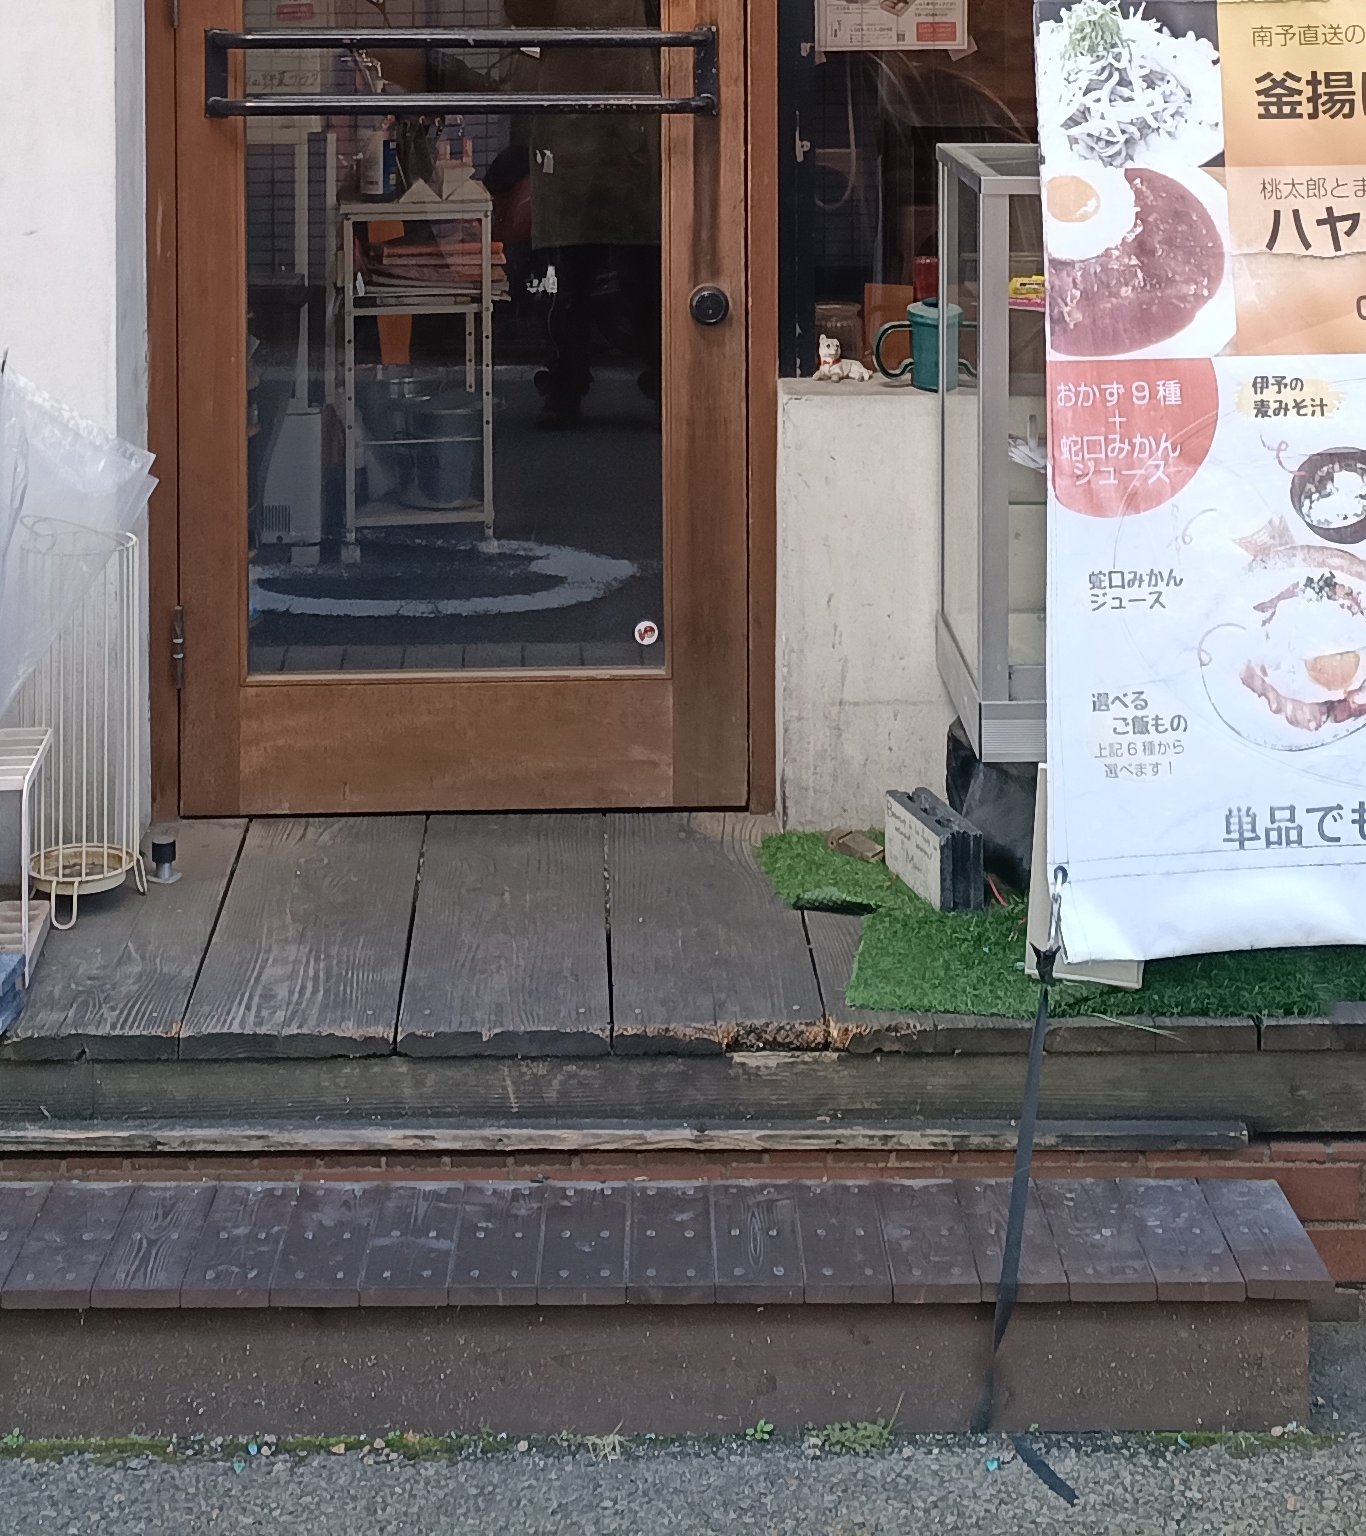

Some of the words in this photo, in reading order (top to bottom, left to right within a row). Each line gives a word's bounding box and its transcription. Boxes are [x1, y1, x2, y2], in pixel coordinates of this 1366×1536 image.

[1055, 378, 1183, 408] おかず9種
[1251, 374, 1305, 395] 伊予の
[1252, 397, 1329, 418] 麦みそ汁
[1060, 432, 1181, 460] 蛇口みかん
[1072, 461, 1171, 486] ジュース
[1088, 567, 1184, 591] 蛇口みかん
[1089, 591, 1167, 613] ジュース
[1091, 690, 1149, 713] 選べる
[1112, 713, 1189, 736] ご飯もの
